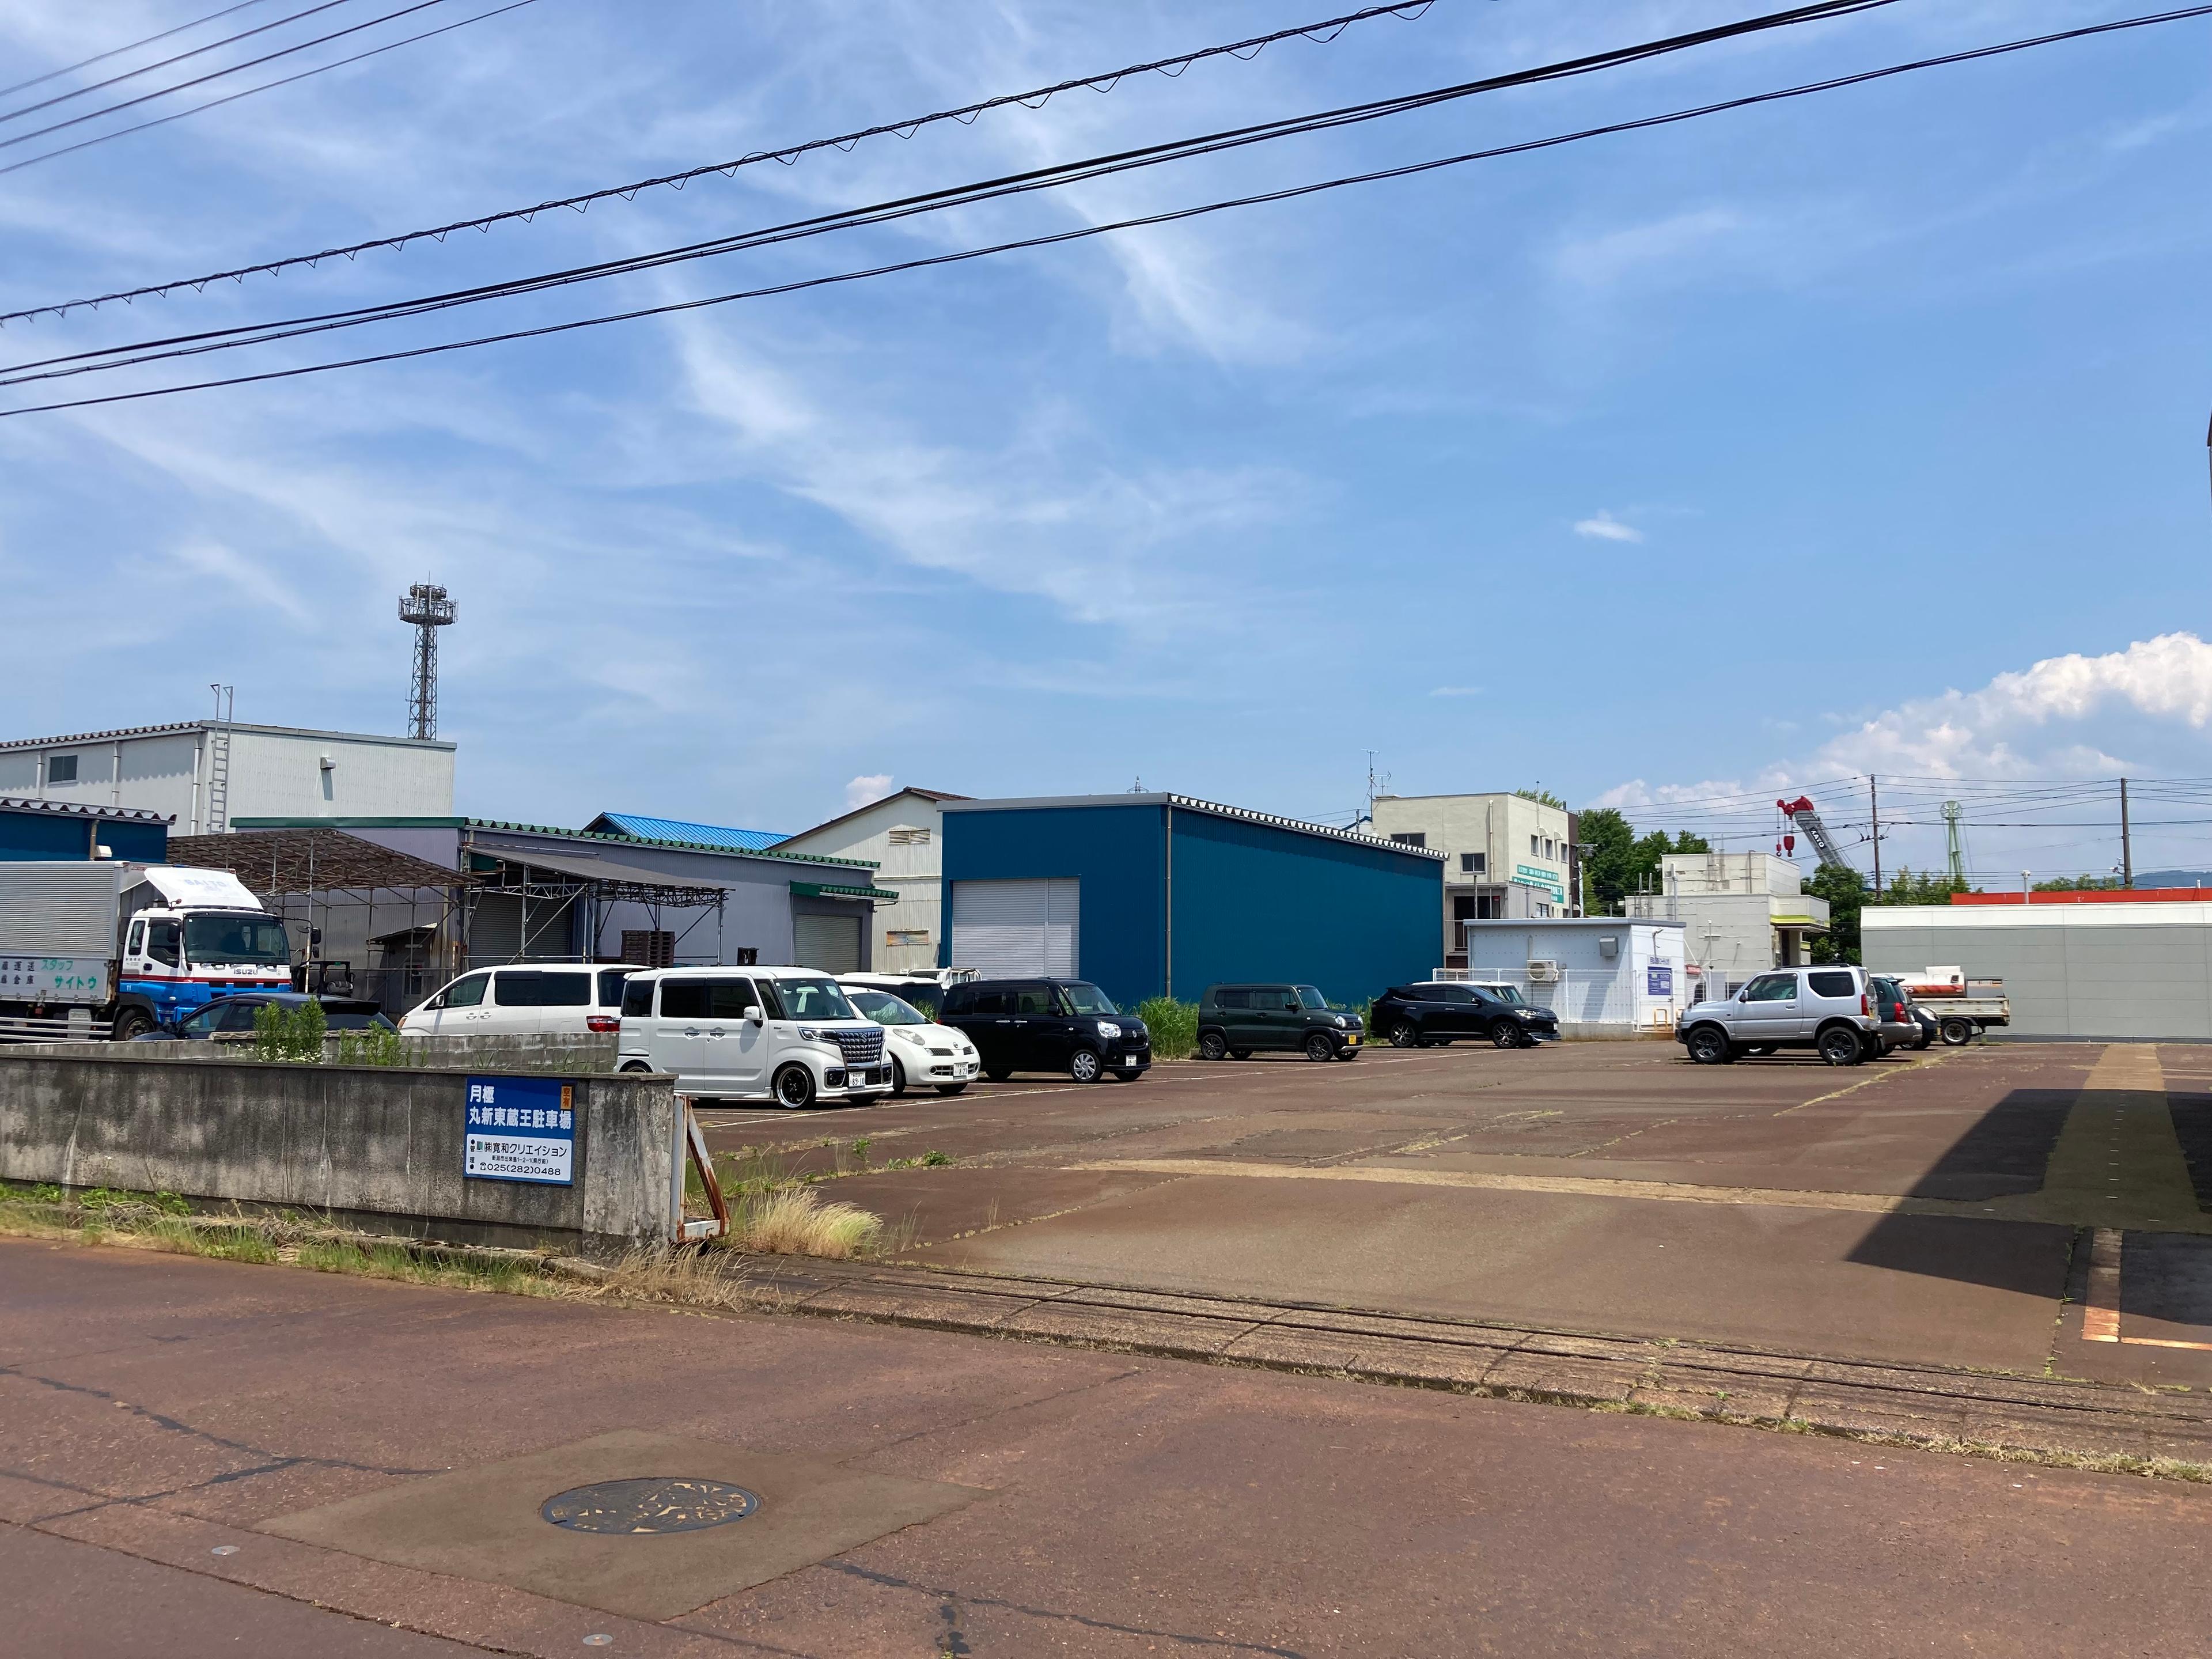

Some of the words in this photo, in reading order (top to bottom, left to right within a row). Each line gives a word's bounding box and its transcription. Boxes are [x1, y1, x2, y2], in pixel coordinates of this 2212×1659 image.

[1810, 830, 1825, 847] KATO
[41, 959, 74, 971] スタッフ
[55, 975, 97, 990] サイトウ
[469, 1085, 494, 1103] 月極
[469, 1106, 571, 1129] 丸新東蔵王駐車場
[487, 1164, 561, 1176] 025(282)0488
